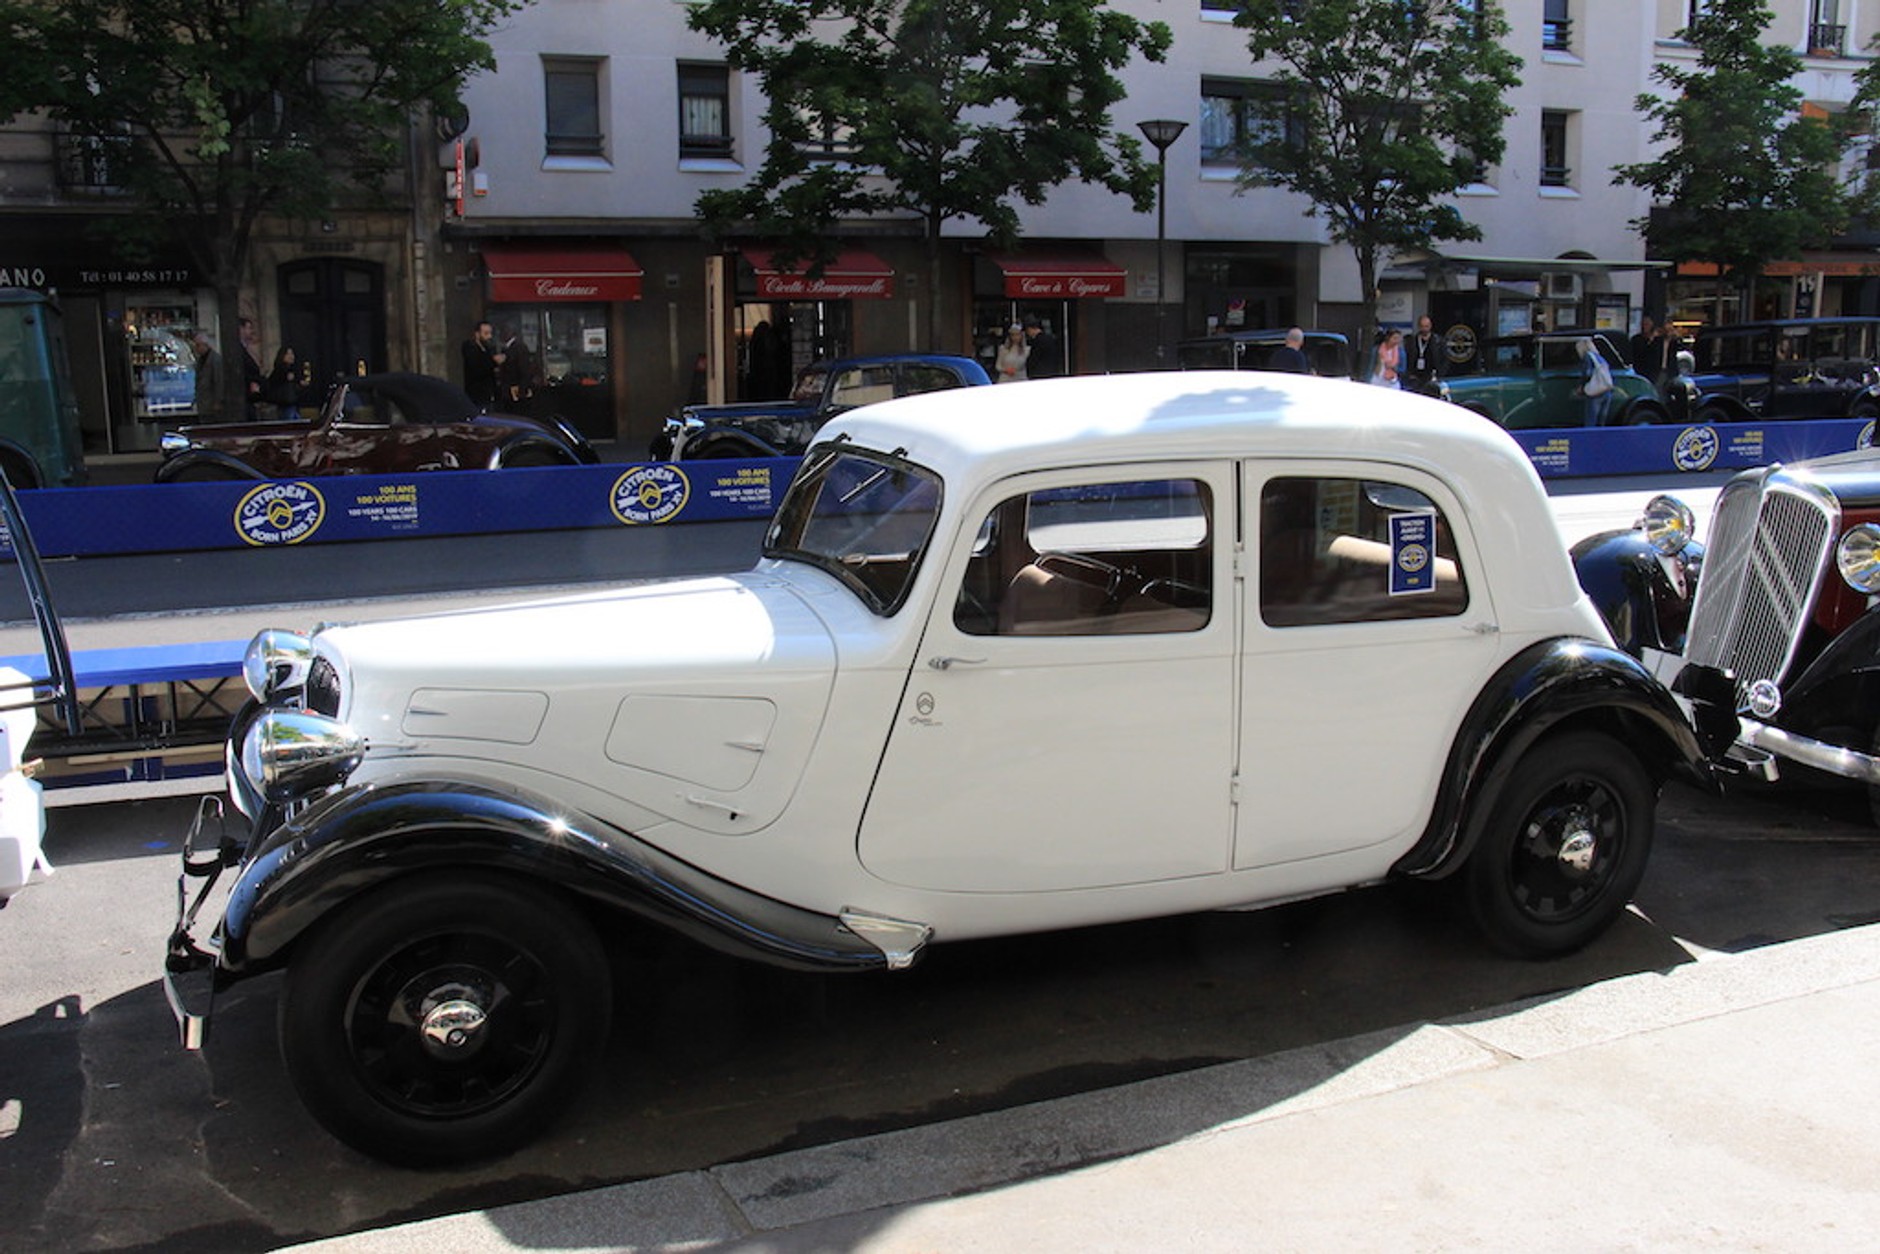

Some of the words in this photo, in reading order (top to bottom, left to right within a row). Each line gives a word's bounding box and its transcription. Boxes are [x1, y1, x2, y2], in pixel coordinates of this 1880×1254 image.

[108, 271, 123, 282] 01
[126, 271, 140, 282] 40
[159, 271, 172, 282] 17
[176, 271, 189, 282] 17
[534, 278, 598, 296] Cadeaux
[1020, 277, 1049, 293] Cave
[1068, 277, 1111, 296] Cigares
[737, 468, 752, 477] 100
[379, 486, 395, 494] 100
[396, 485, 417, 493] ANS
[356, 496, 374, 504] 100
[374, 494, 417, 504] VOITURES
[250, 528, 280, 542] BORN
